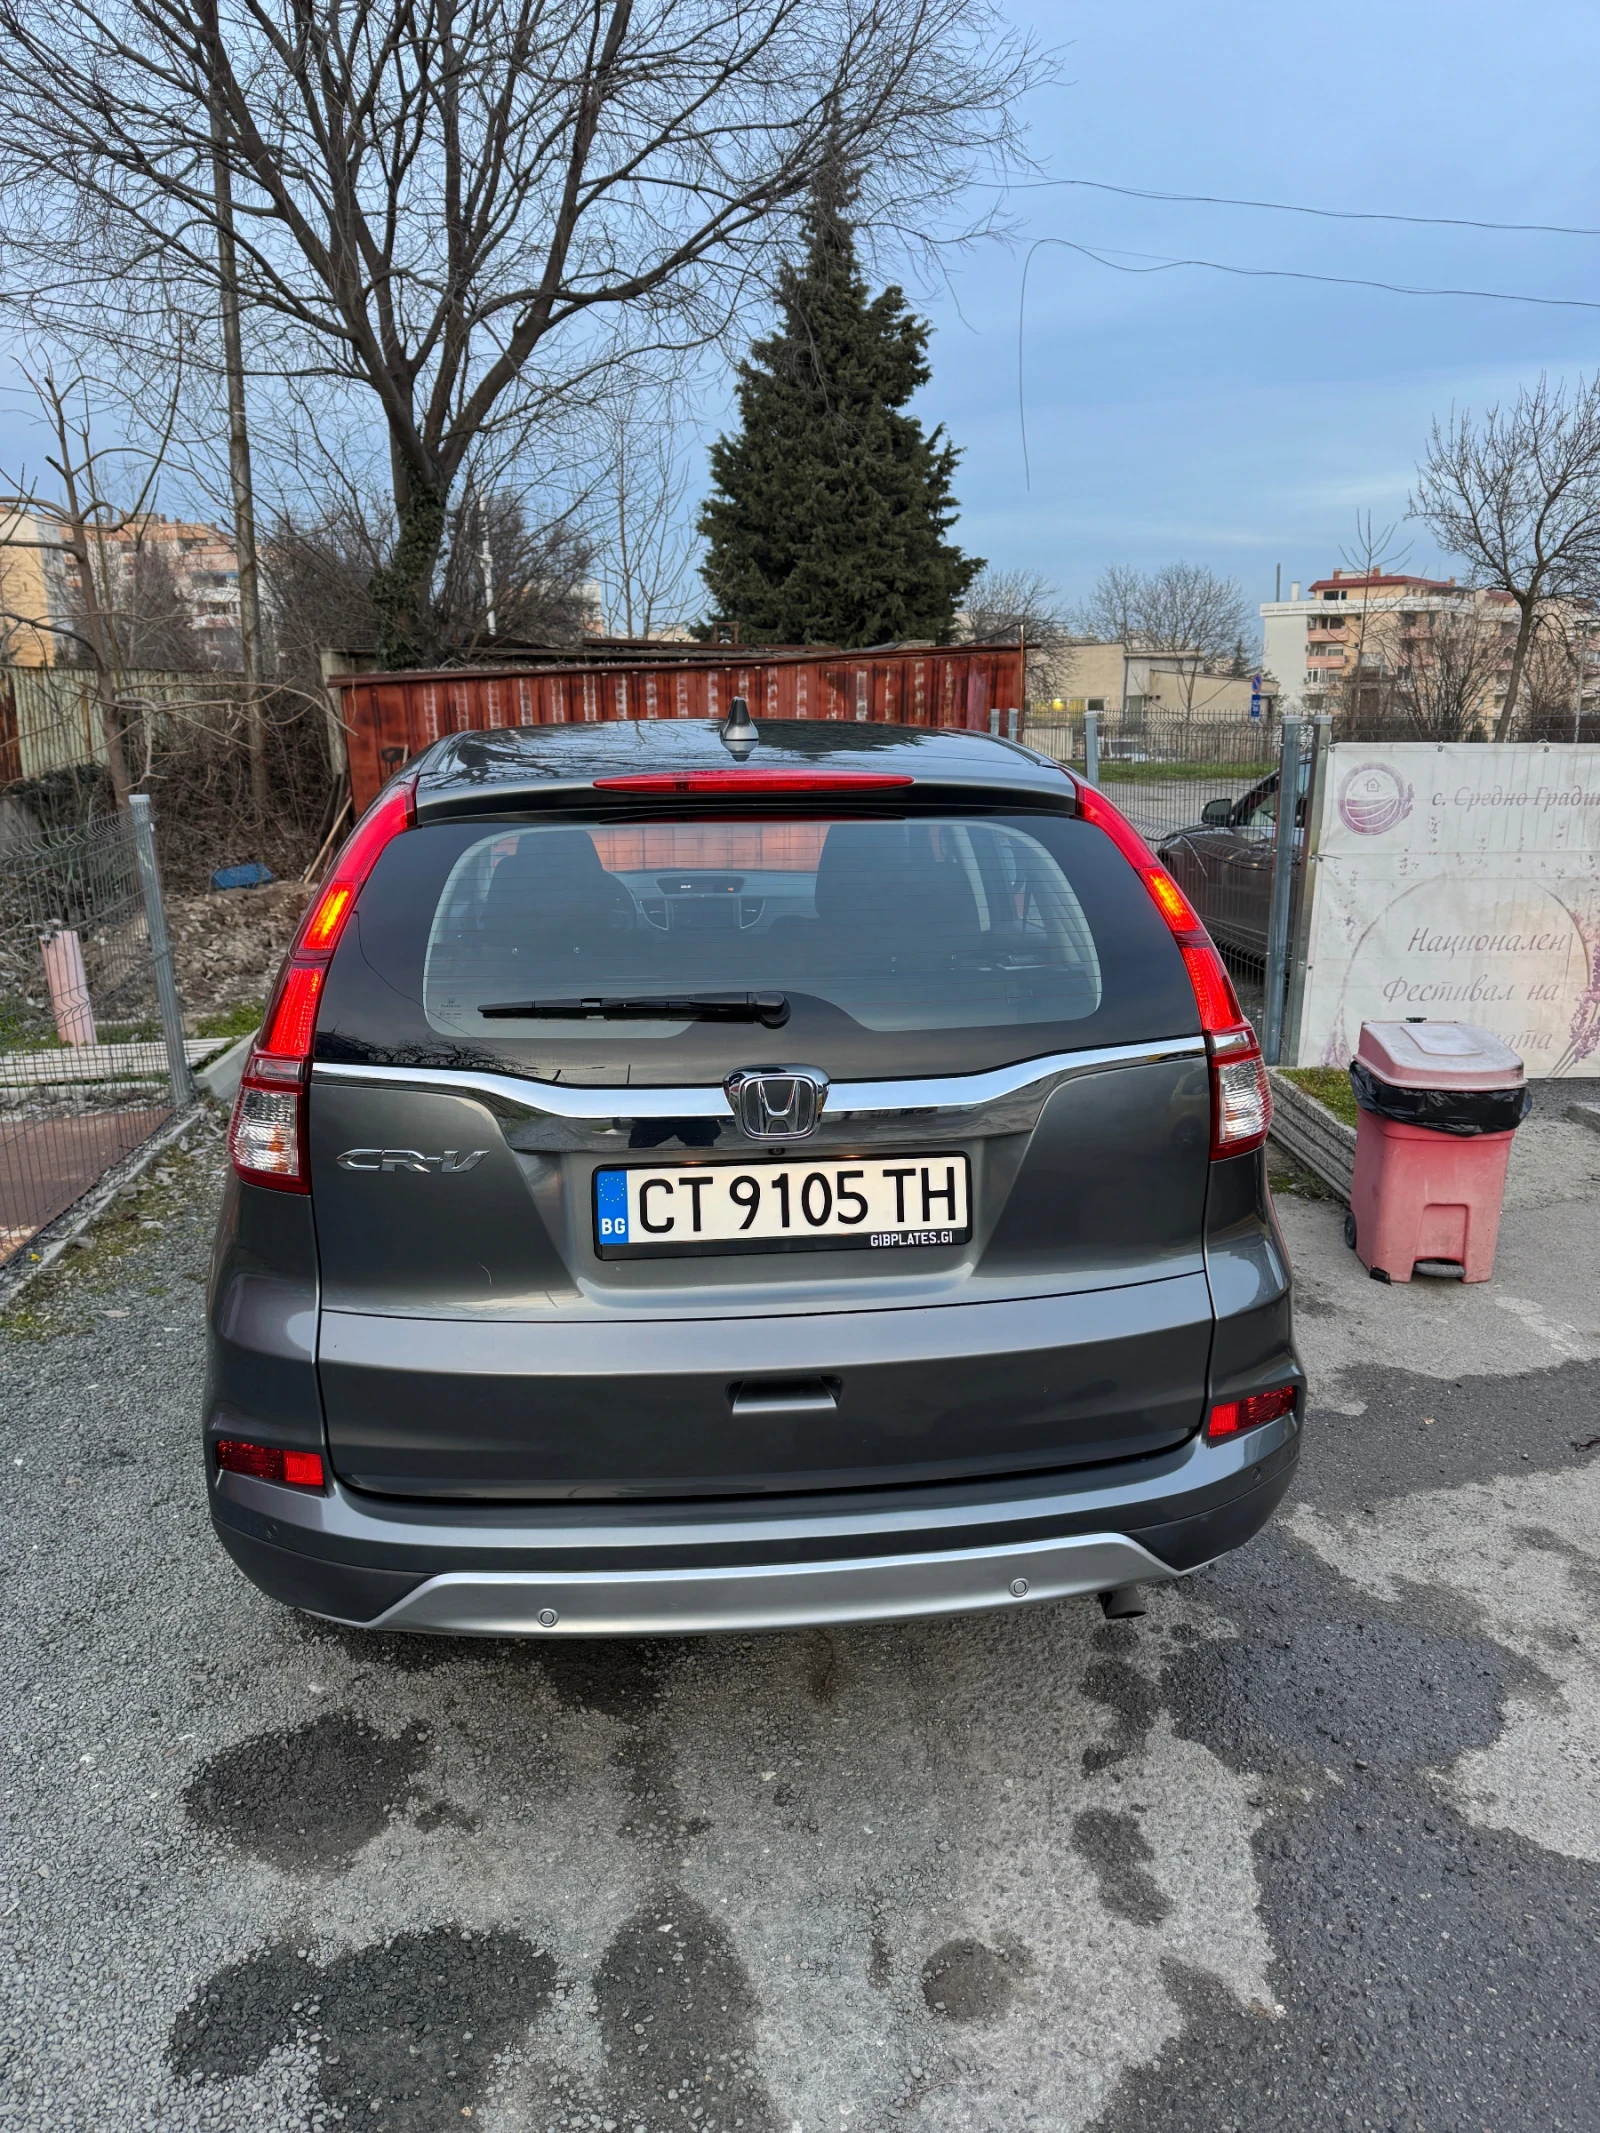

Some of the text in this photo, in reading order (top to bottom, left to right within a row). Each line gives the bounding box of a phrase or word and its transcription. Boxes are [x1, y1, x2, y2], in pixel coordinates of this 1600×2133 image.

[1454, 784, 1528, 813] Средно
[1407, 926, 1566, 963] Национален
[1383, 973, 1561, 1003] Фестивал на
[336, 1148, 490, 1173] CR-V
[601, 1166, 956, 1235] BG CT 9105 TH
[870, 1230, 953, 1247] GIBPLATES.GI
